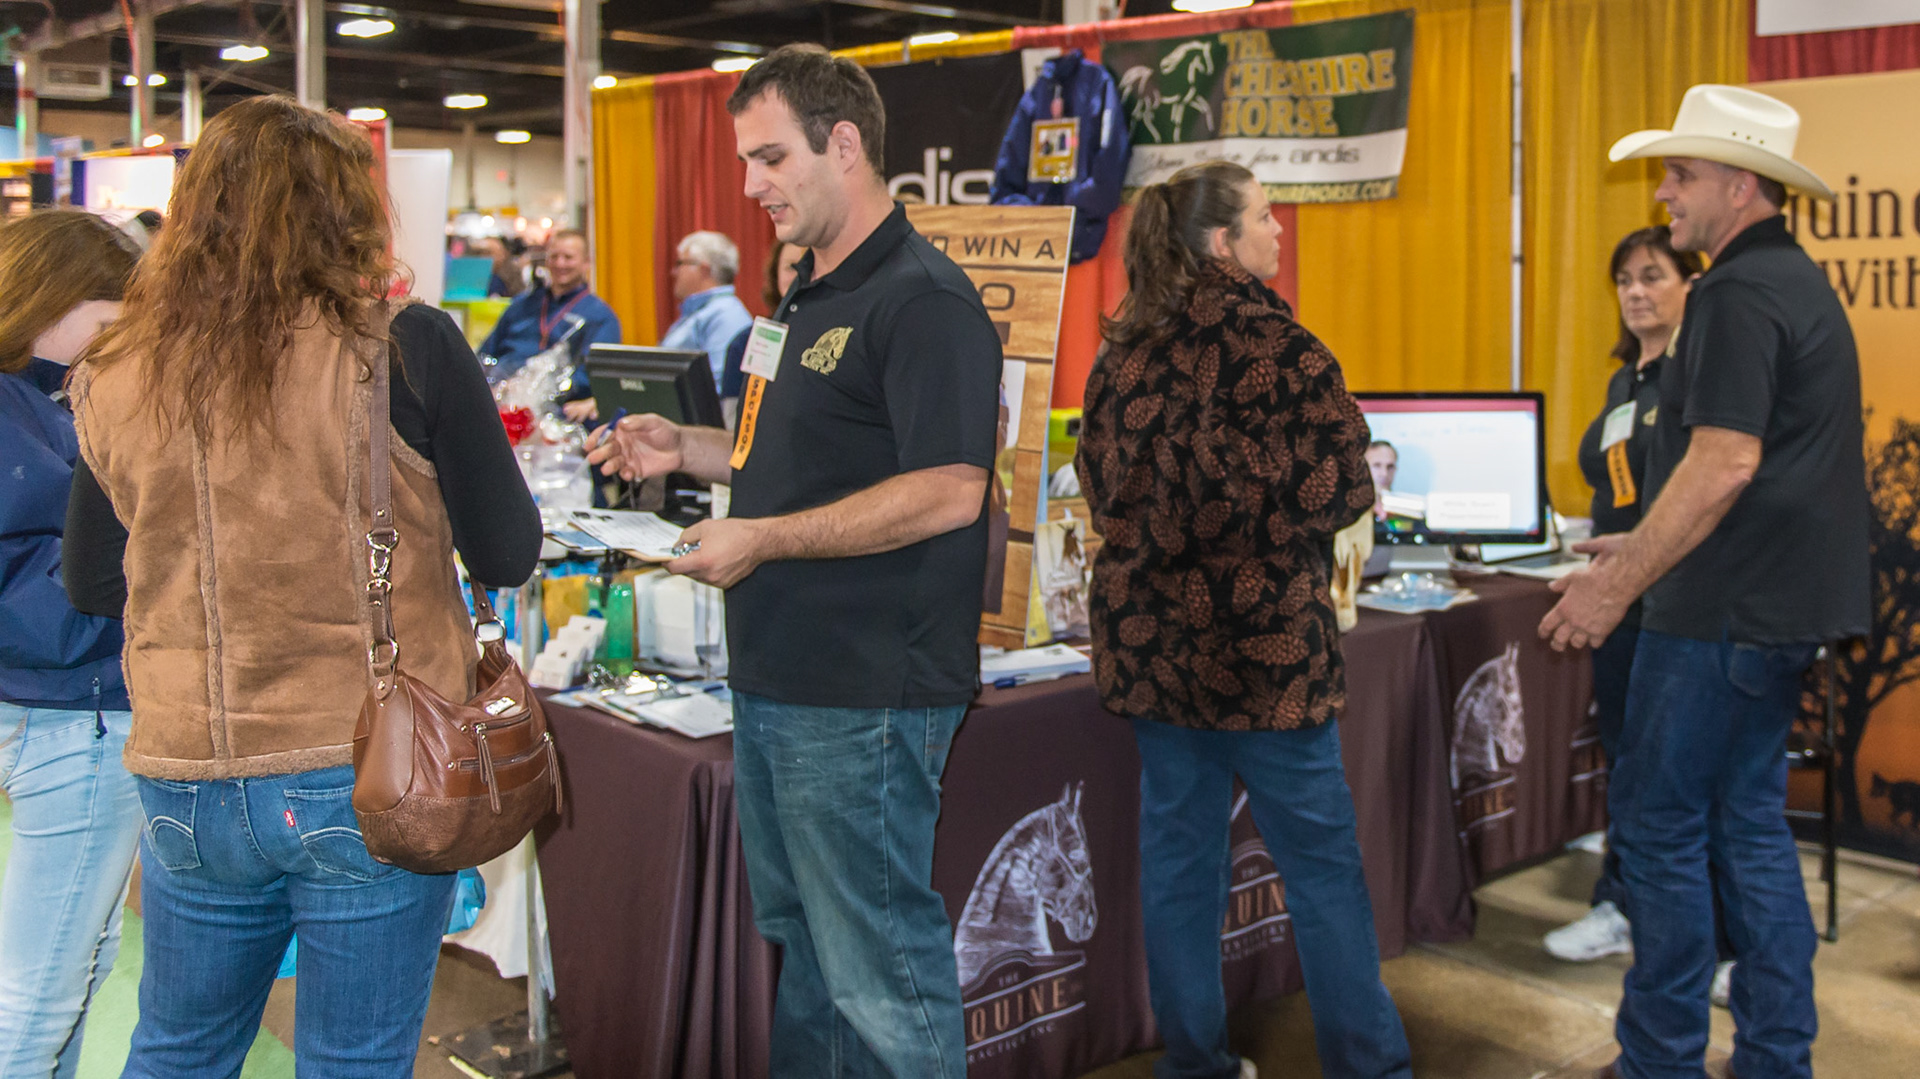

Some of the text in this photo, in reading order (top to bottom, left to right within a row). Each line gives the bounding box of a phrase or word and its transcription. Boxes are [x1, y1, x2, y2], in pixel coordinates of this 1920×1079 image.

[1223, 48, 1396, 97] CHESHIRE
[1219, 97, 1339, 136] HORSE
[963, 236, 1021, 258] WIN
[1035, 239, 1055, 259] A
[971, 976, 1069, 1042] QUINE
[967, 1033, 1027, 1063] RACTICE
